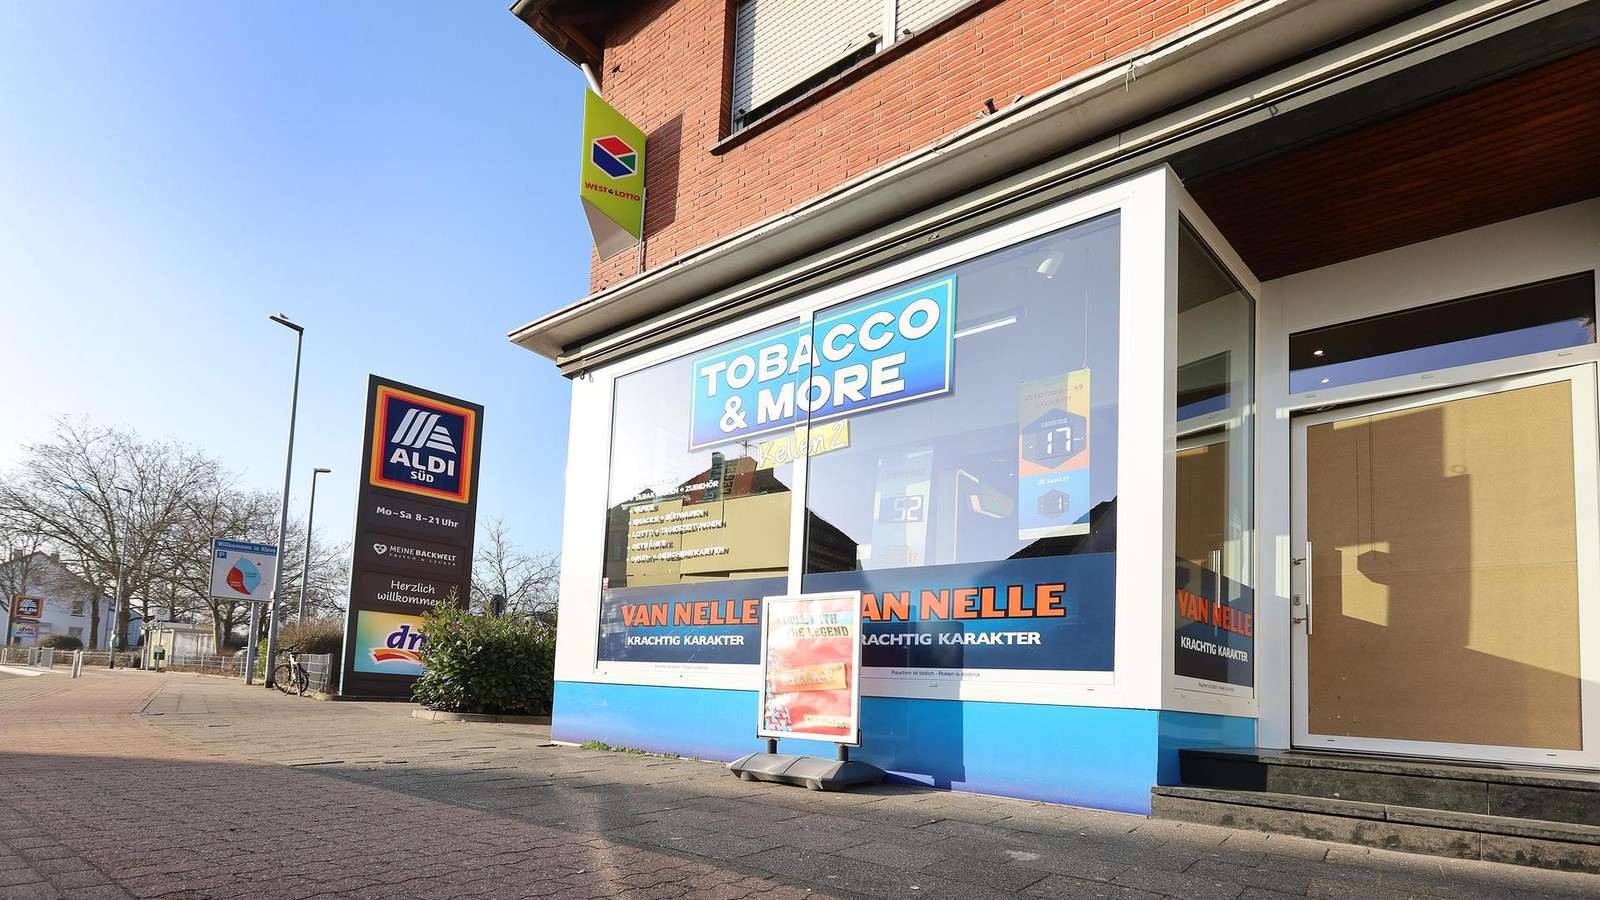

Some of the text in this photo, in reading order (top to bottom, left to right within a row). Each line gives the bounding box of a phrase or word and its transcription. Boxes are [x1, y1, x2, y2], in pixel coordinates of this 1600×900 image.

[700, 298, 941, 397] TOBACCO
[719, 351, 906, 433] & MORE
[758, 420, 847, 468] Kellen 2
[1046, 426, 1072, 456] 17
[389, 448, 454, 476] ALDI
[410, 469, 434, 484] SÜD
[684, 479, 719, 492] ZUBEHÖR
[441, 517, 459, 528] Uhr
[217, 541, 253, 550] Willkommen
[389, 545, 457, 562] MEINE BACKWELT
[391, 580, 435, 594] Herzlich
[861, 582, 1067, 621] AN NELLE
[620, 598, 760, 628] VAN NELLE
[1177, 589, 1252, 638] VAN NELLE
[627, 635, 744, 646] KRACHTIG KARAKTER
[808, 626, 849, 637] LEGEND
[861, 631, 1042, 646] RACHTIG KARAKTER
[1180, 635, 1249, 663] KRACHTIG KARAKTER
